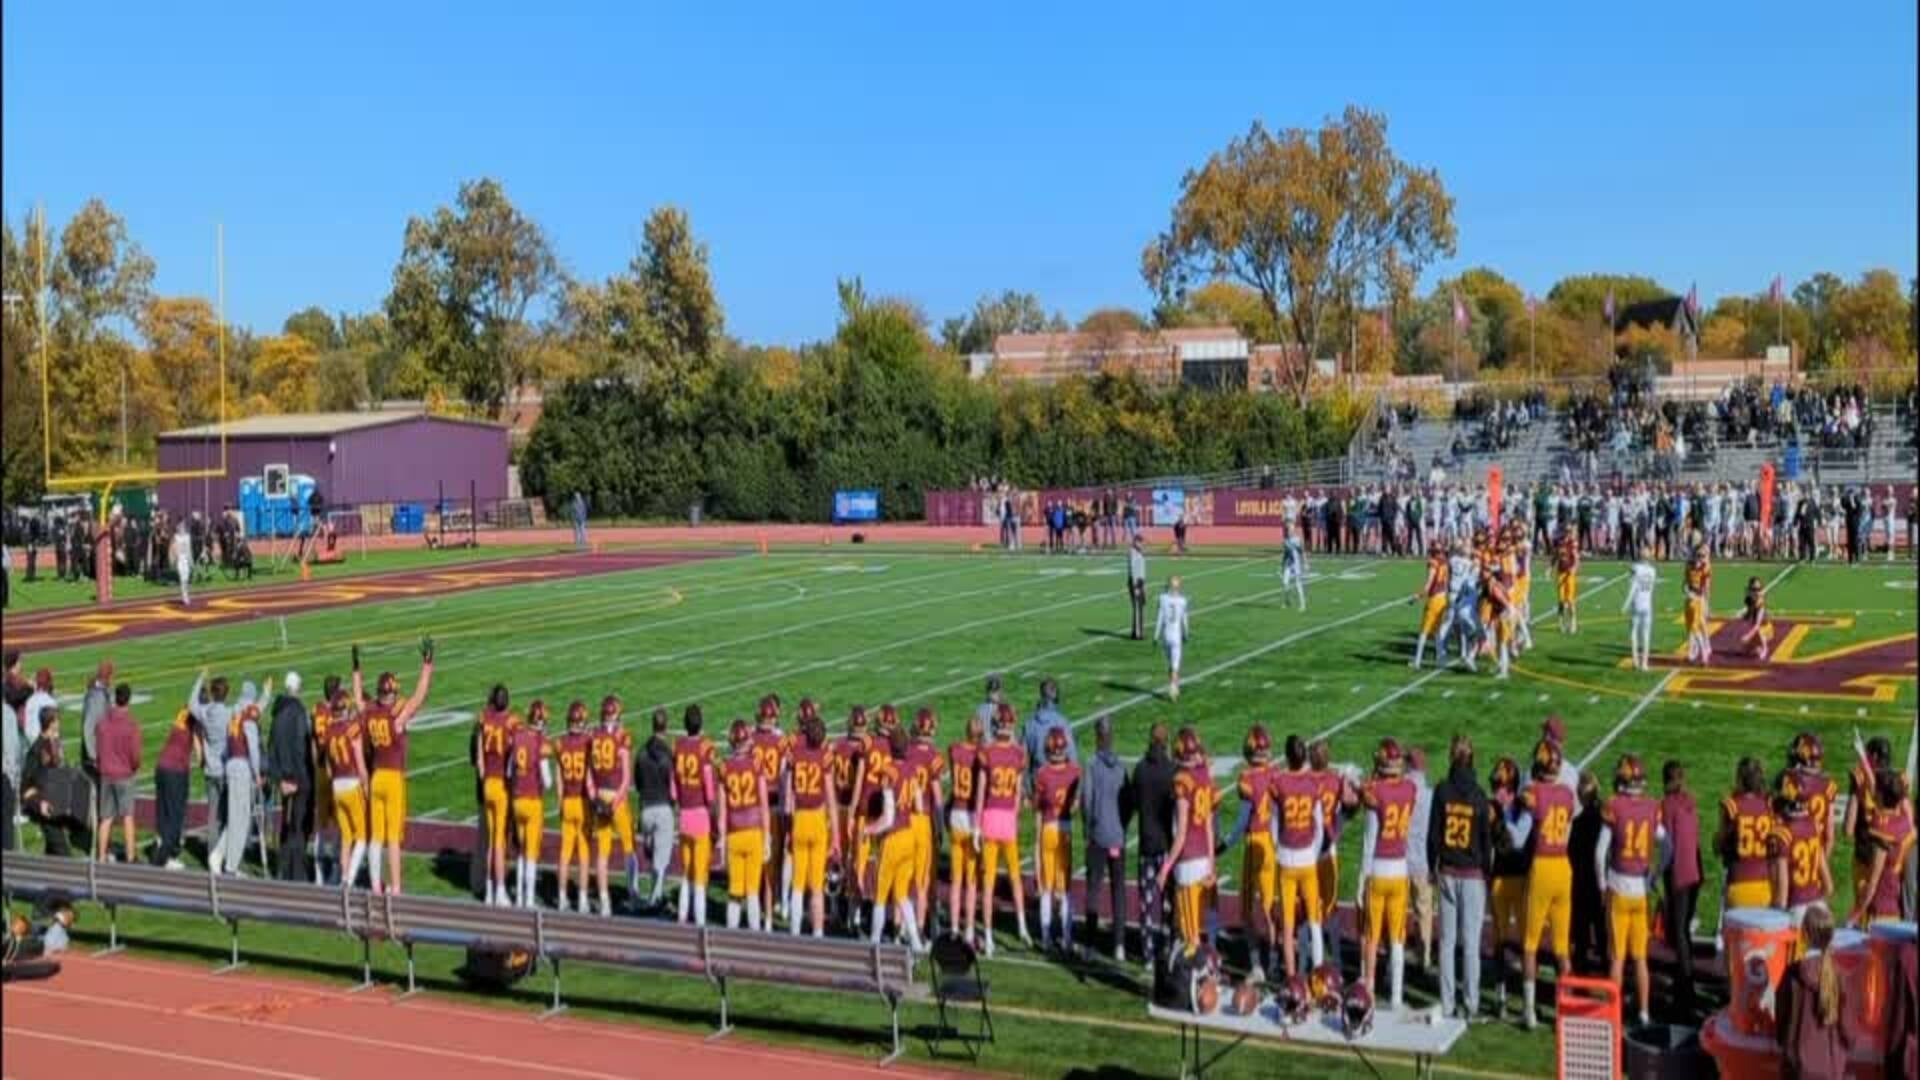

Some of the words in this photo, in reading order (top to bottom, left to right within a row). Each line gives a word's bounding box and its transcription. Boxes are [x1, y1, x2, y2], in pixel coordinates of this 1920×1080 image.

[1284, 796, 1312, 828] 22
[1381, 802, 1410, 840] 24
[1444, 815, 1471, 849] 23
[1622, 819, 1650, 860] 14
